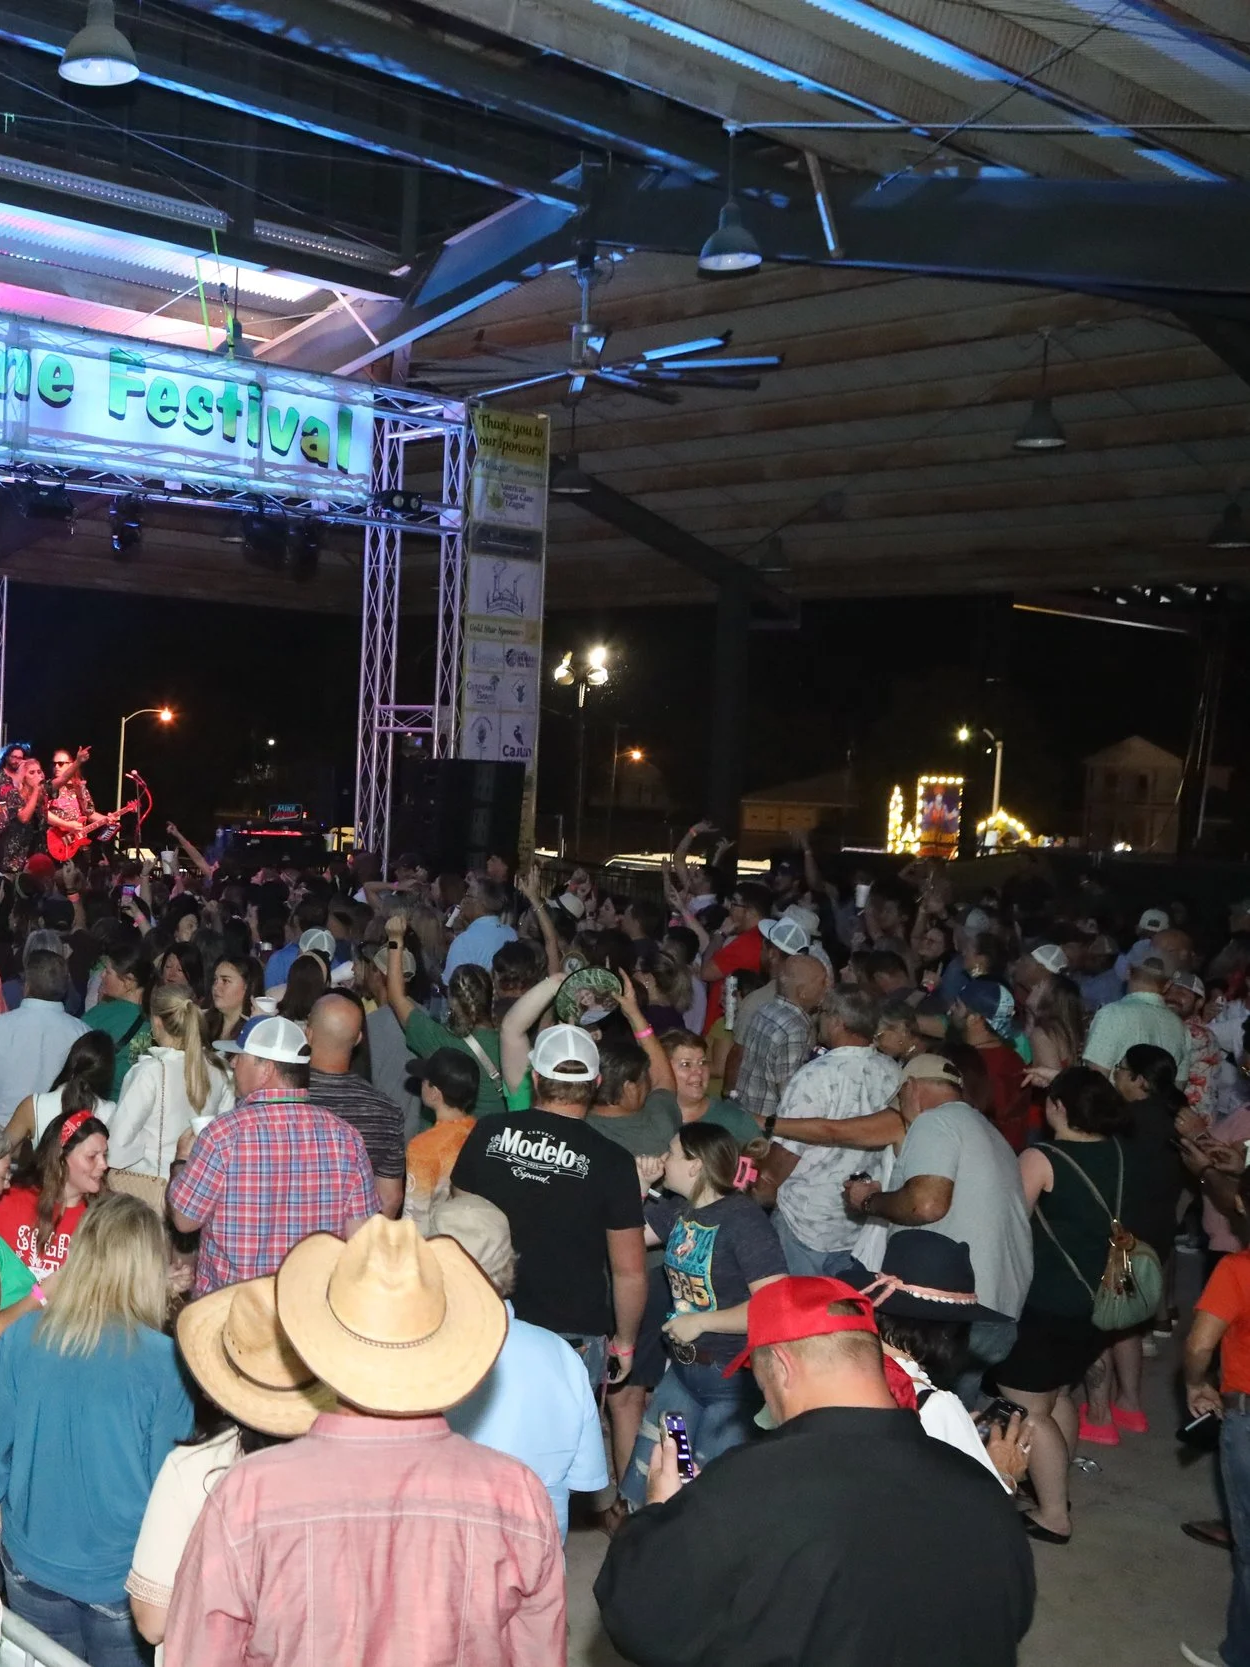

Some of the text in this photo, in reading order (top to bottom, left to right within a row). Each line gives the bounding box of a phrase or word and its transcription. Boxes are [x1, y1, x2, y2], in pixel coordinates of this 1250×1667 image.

[108, 347, 353, 475] Festival
[478, 413, 543, 438] Thank you to
[479, 436, 497, 448] our
[498, 1126, 576, 1168] Modelo
[527, 1130, 556, 1141] CERVEZA
